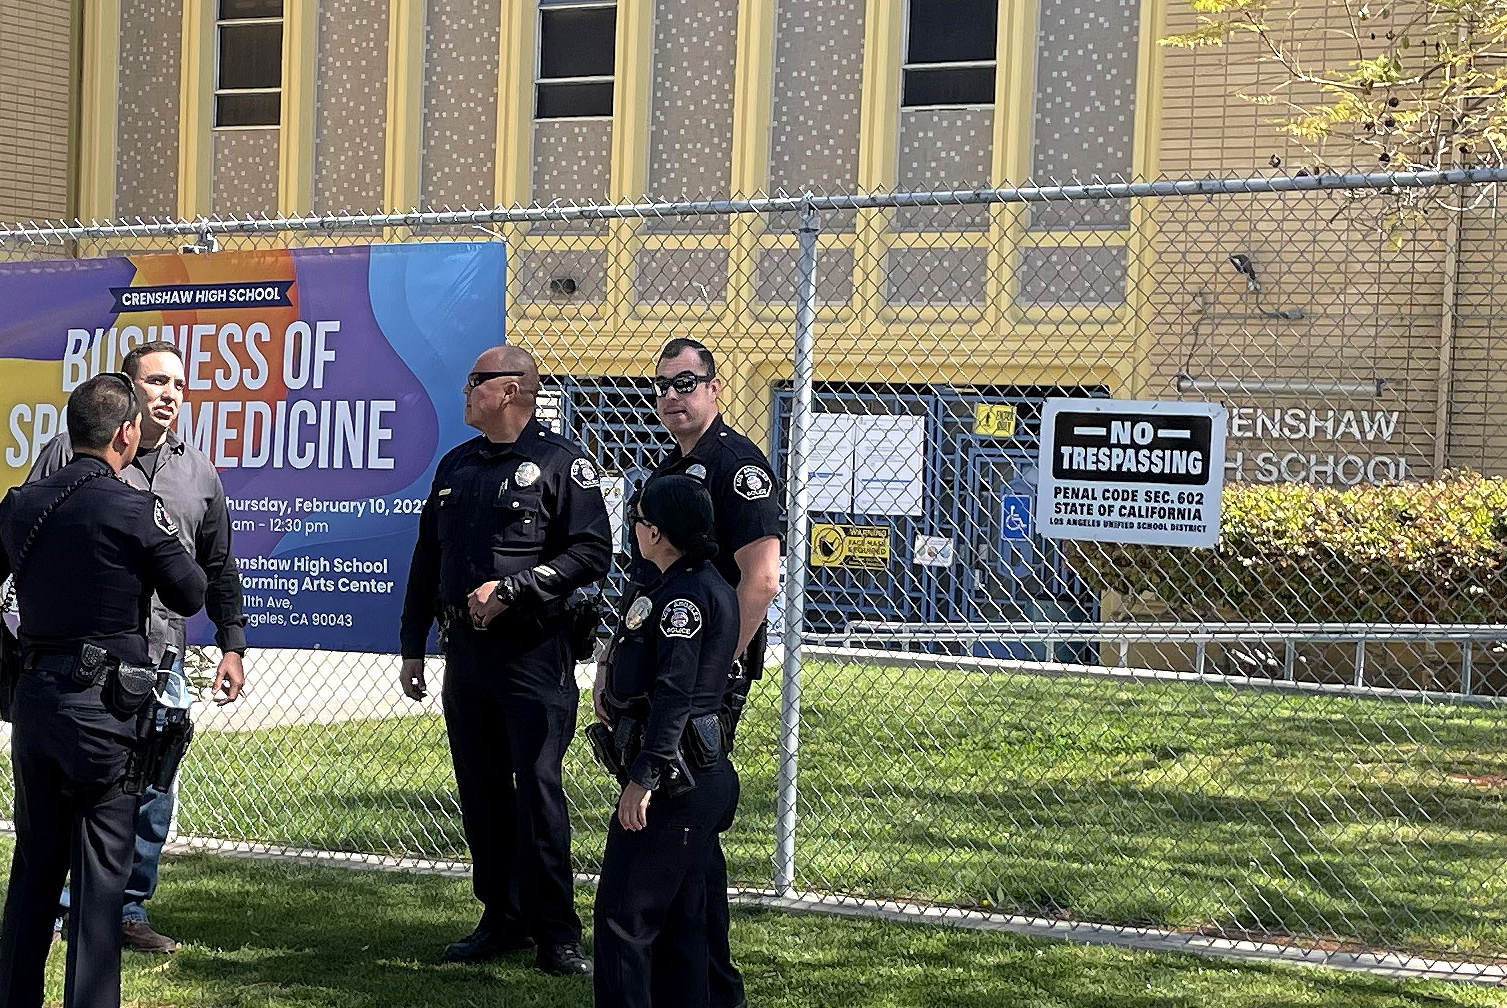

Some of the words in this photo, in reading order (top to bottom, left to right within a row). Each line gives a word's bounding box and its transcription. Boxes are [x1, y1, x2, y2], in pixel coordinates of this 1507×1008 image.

[121, 290, 193, 306] CRENSHAW
[195, 289, 227, 303] HIGH
[228, 286, 281, 302] SCHOOL
[62, 322, 269, 393] BUSNESS
[283, 320, 341, 390] OF
[177, 399, 396, 470] MEDICINE
[1109, 420, 1154, 446] NO
[1226, 407, 1399, 441] ENSHAW
[1060, 445, 1203, 475] TRESPASSING
[1255, 452, 1407, 486] SCHOOL
[1053, 486, 1097, 500] PENAL
[1102, 488, 1139, 502] CODE
[1144, 490, 1174, 504] SEC.
[1177, 491, 1204, 506] 602
[225, 496, 291, 517] hursday,
[295, 497, 366, 518] February
[369, 498, 390, 517] 10,
[393, 498, 427, 515] 202
[1054, 502, 1094, 516] STATE
[1097, 503, 1115, 517] OF
[1118, 504, 1203, 521] CALIFORNIA
[231, 519, 255, 531] am
[269, 518, 302, 532] 12:30
[305, 520, 329, 535] pm
[1049, 517, 1064, 526] LOS
[1066, 518, 1101, 528] ANGELES
[1103, 520, 1135, 530] UNIFIED
[1136, 522, 1168, 531] SCHOOL
[1170, 523, 1207, 533] DISTRICT
[235, 555, 291, 571] enshaw
[293, 556, 330, 576] High
[333, 557, 388, 574] School
[239, 573, 299, 594] forming
[301, 576, 335, 592] Arts
[337, 577, 394, 593] Center
[266, 596, 293, 610] Ave,
[243, 612, 287, 627] ngeles,
[289, 613, 308, 625] CA
[312, 613, 353, 627] 90043
